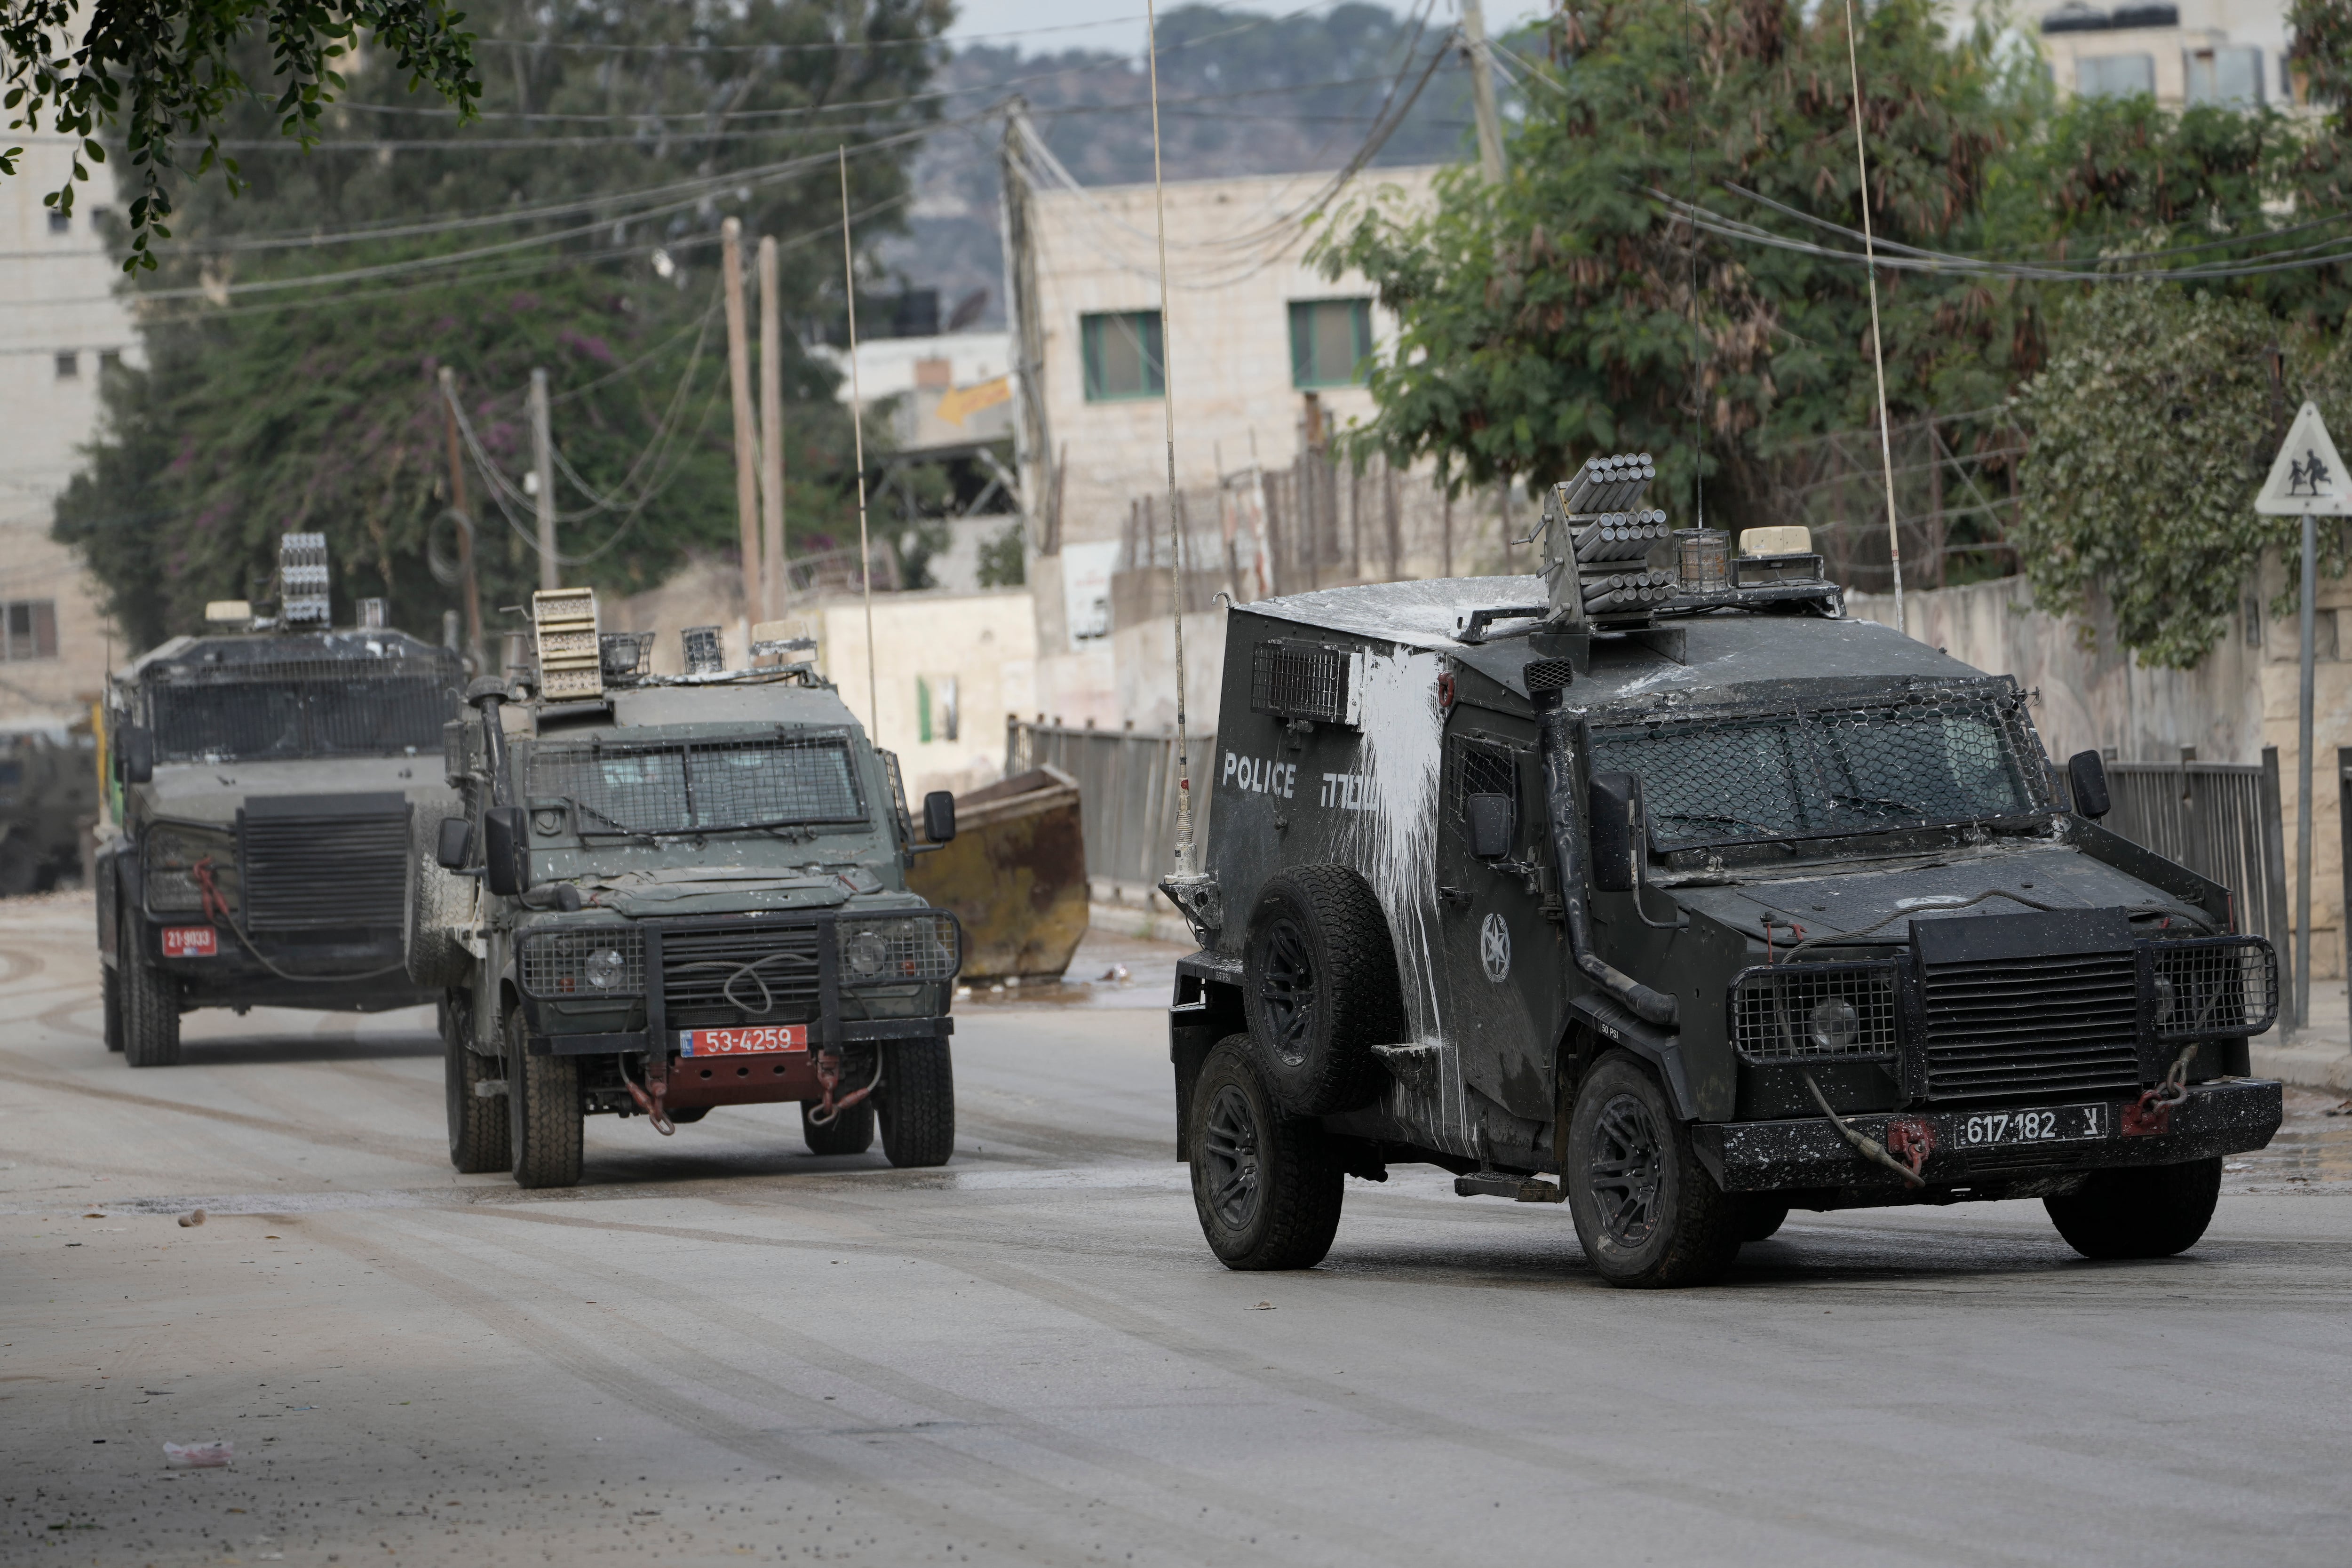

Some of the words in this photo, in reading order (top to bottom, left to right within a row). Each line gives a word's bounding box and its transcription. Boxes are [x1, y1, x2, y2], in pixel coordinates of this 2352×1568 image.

[1222, 751, 1297, 799] POLICE
[1216, 971, 1222, 980] 55
[706, 1028, 791, 1052] 53-4259
[1602, 1024, 1608, 1034] 50
[1610, 1028, 1619, 1039] PSI
